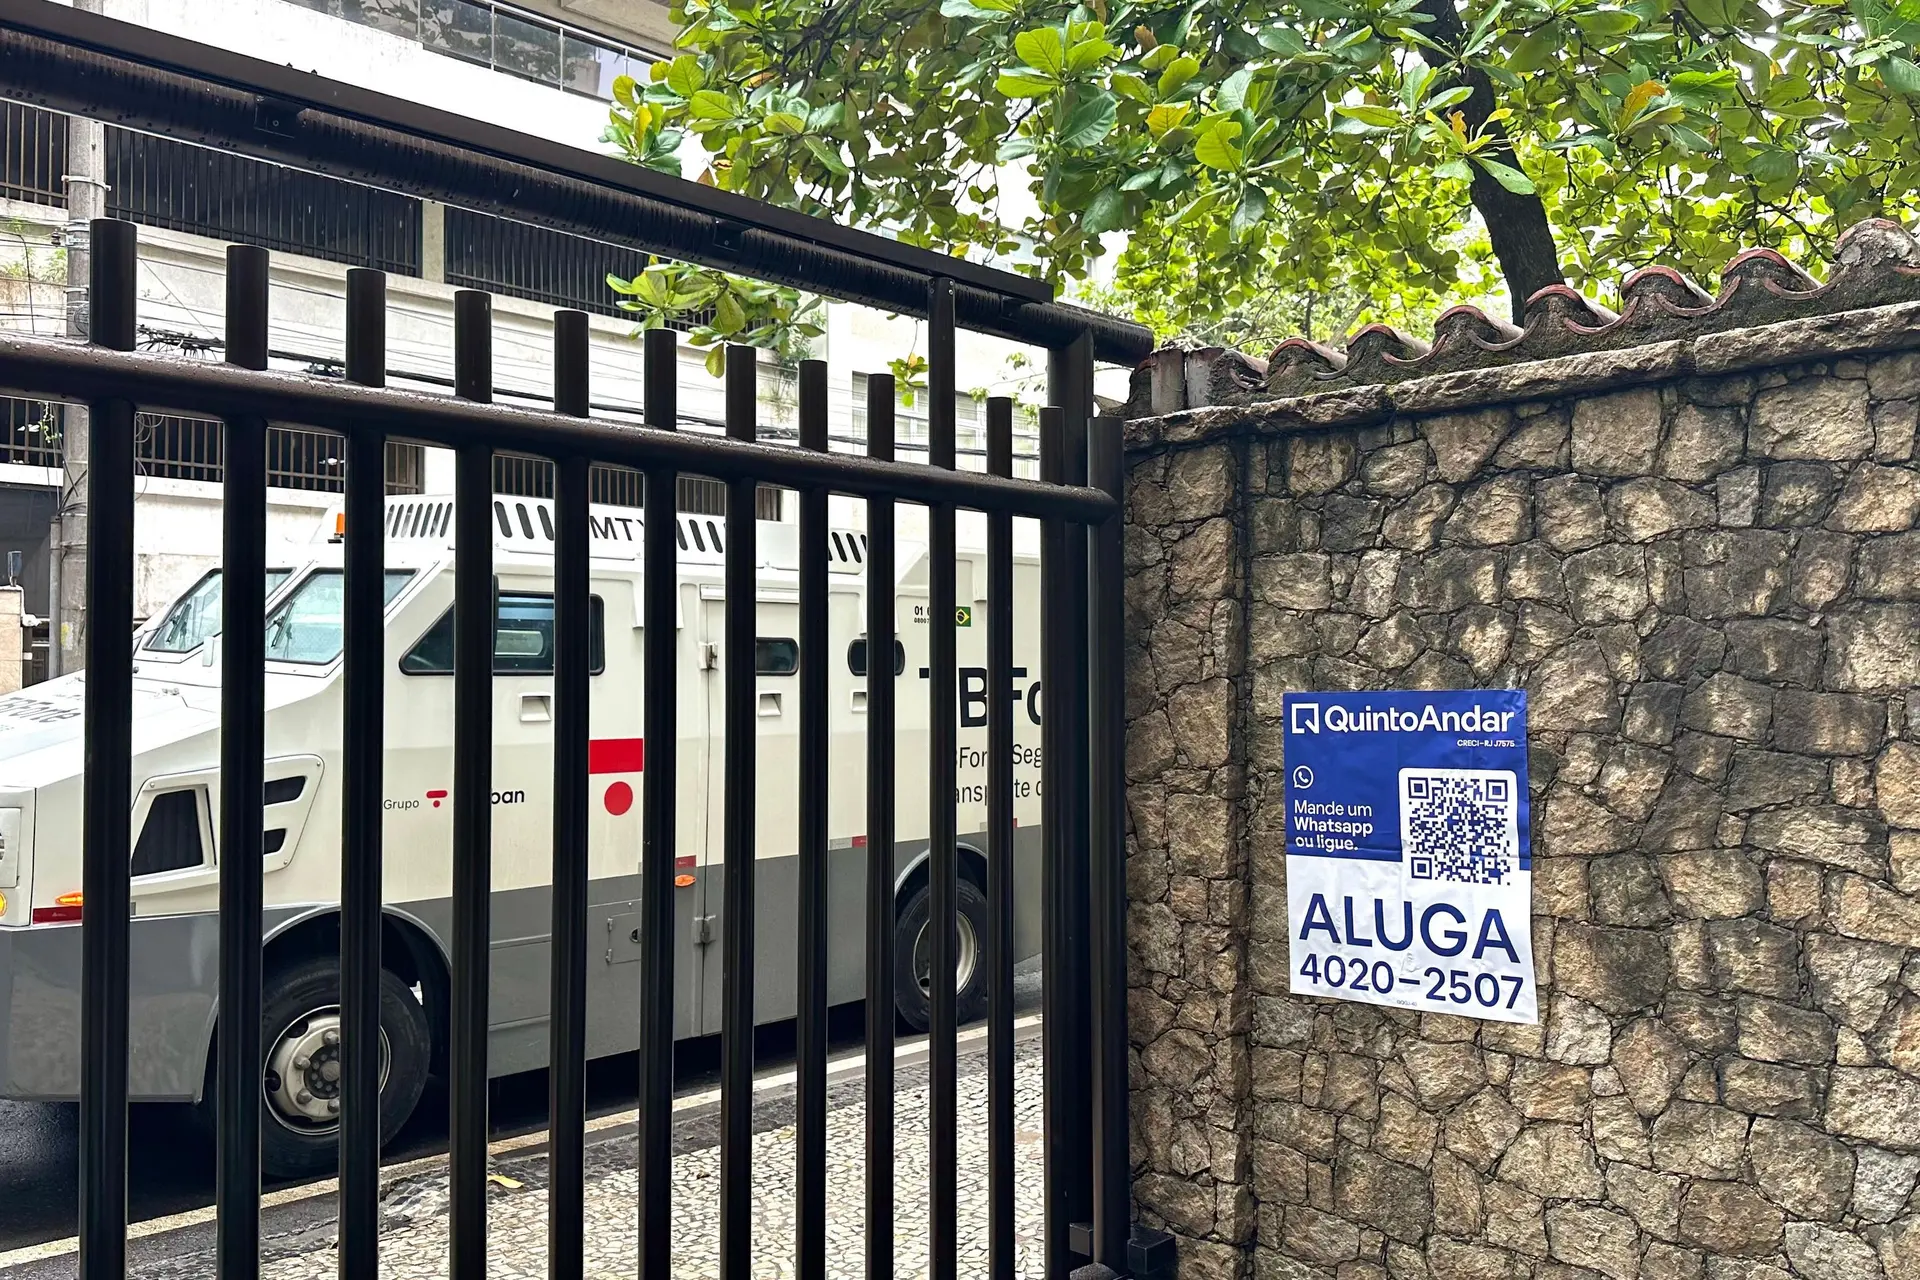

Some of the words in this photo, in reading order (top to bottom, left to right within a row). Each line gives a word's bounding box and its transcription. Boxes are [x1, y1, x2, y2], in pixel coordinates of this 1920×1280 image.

[1324, 704, 1515, 733] QuintoAndar
[383, 799, 419, 810] Grupo
[1294, 799, 1345, 816] Mande
[1347, 803, 1372, 817] um
[1294, 816, 1373, 837] Whatsapp
[1295, 836, 1315, 848] ou
[1317, 834, 1359, 852] ligue.
[1299, 893, 1521, 964] ALUGA
[1300, 953, 1524, 1009] 4020-2507
